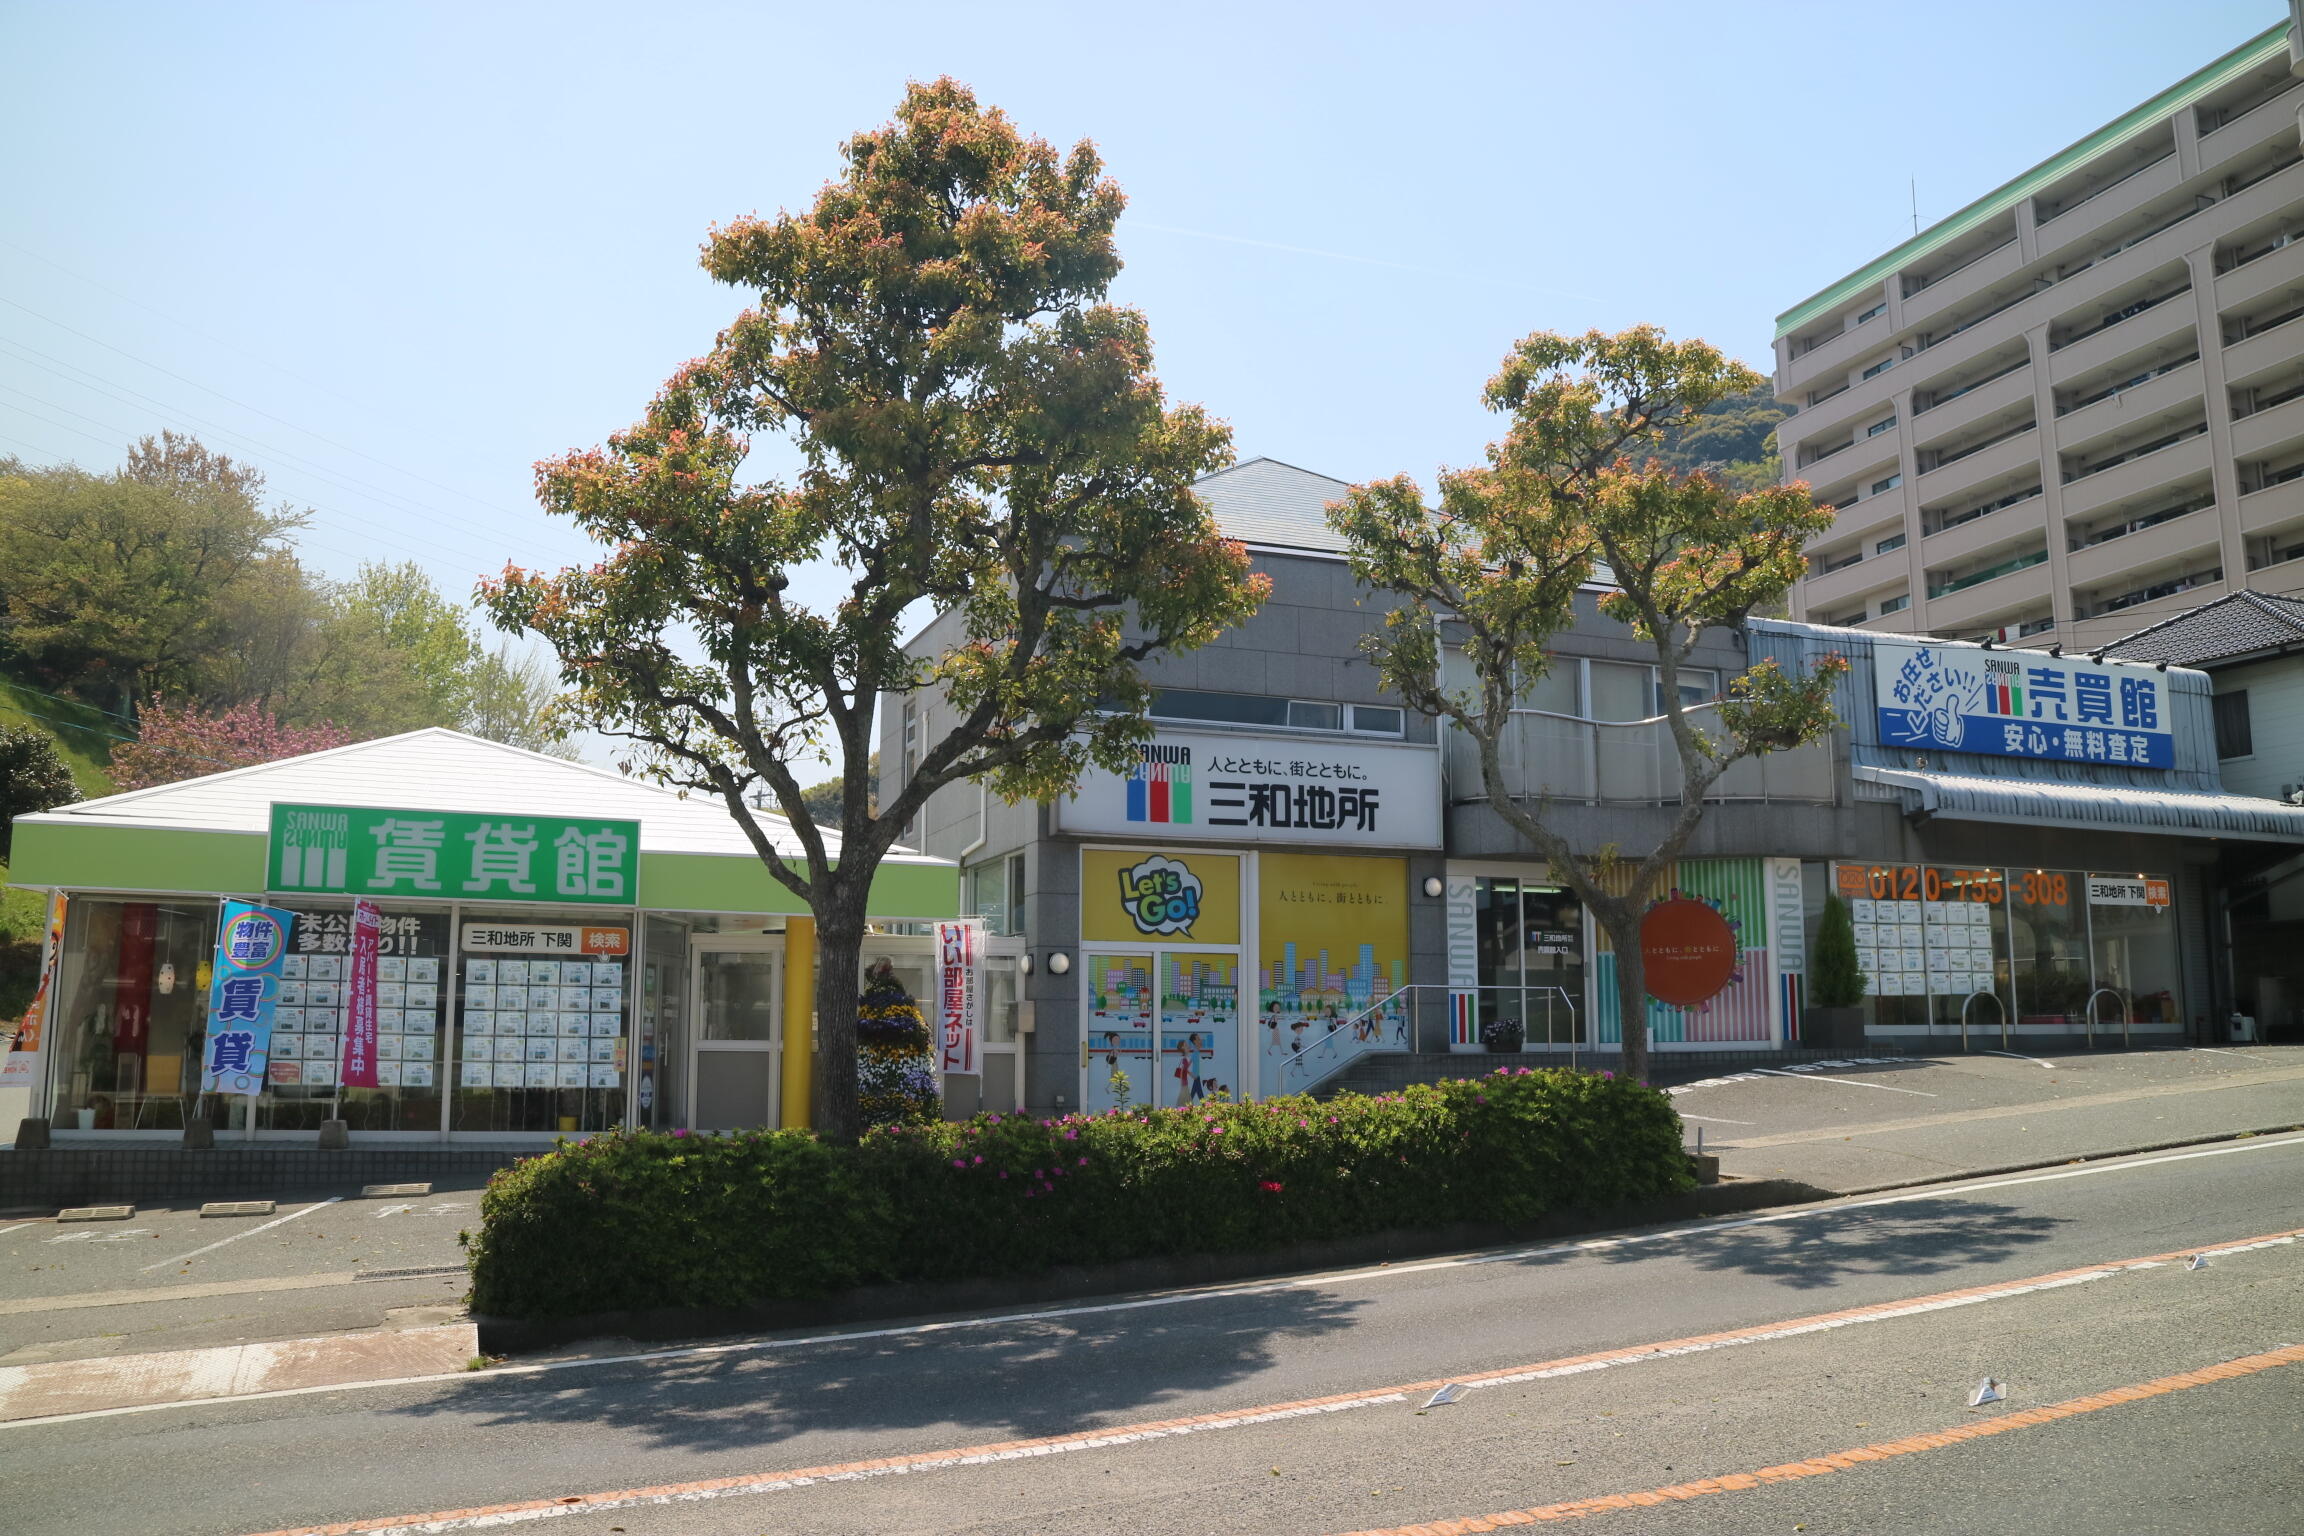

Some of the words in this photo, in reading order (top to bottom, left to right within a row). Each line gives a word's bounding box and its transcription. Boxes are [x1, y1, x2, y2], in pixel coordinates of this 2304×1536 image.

[1894, 647, 1934, 704] お任せ
[1984, 659, 2020, 675] SANWA
[2027, 667, 2158, 729] 売買館
[2004, 723, 2150, 763] 安心・無料査定
[1207, 756, 1368, 781] 人とともに、街とともに。
[286, 811, 348, 831] SANWA
[1208, 781, 1379, 831] 三和地所
[367, 818, 627, 897] 賃貸館
[1119, 869, 1181, 899] Let's
[2091, 884, 2125, 898] 三和地所
[2128, 885, 2145, 899] 下関
[299, 913, 421, 935] 未公物件
[1139, 887, 1198, 924] Go!
[1776, 865, 1803, 970] SANWA
[236, 921, 273, 938] 物件
[298, 932, 418, 954] 多数り!!
[471, 930, 535, 947] 三和地所
[541, 932, 572, 947] 下関
[589, 933, 621, 948] 検索
[1448, 883, 1474, 987] SANWA
[231, 941, 269, 959] 豊富
[940, 924, 963, 1071] いい部屋ネット
[965, 968, 974, 1026] お部屋さがしは
[210, 977, 264, 1075] 賃貸
